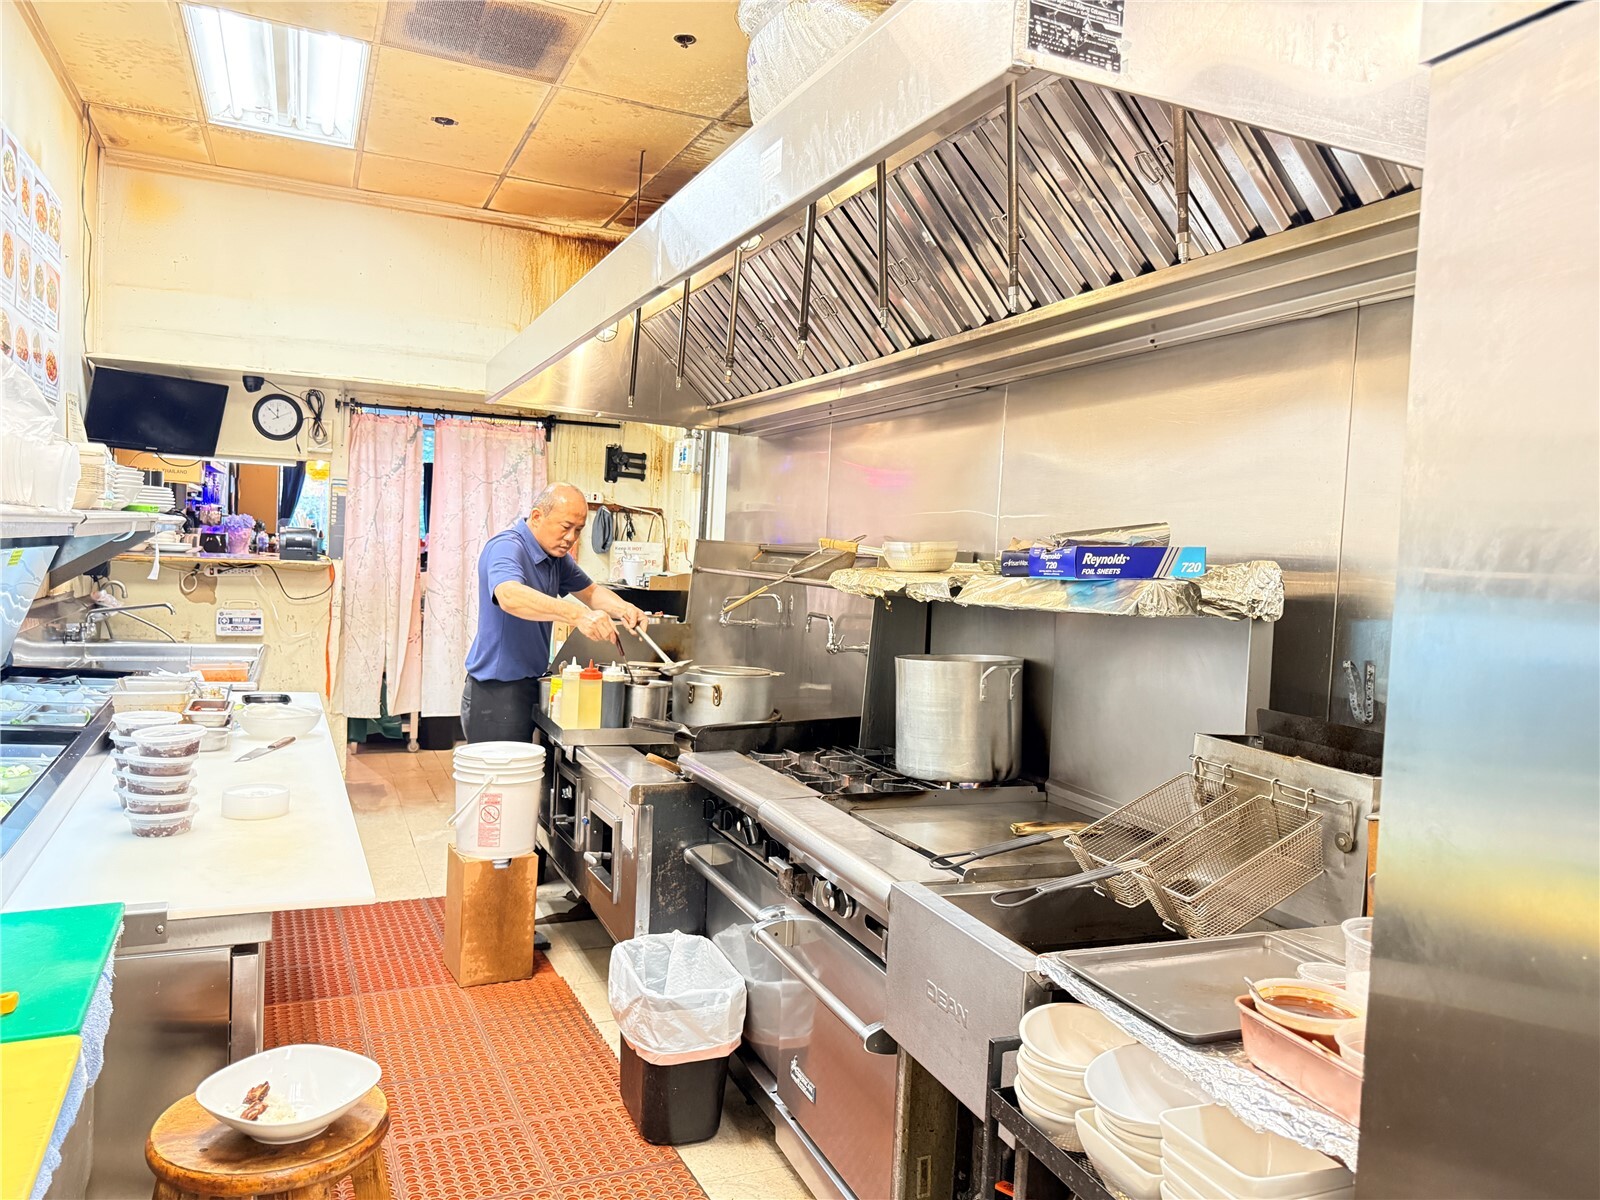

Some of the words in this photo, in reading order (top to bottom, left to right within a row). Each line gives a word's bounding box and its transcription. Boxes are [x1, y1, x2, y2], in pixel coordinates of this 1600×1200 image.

[1045, 561, 1058, 569] 720
[1082, 552, 1128, 567] Reynolds
[1181, 562, 1202, 573] 720
[926, 979, 969, 1030] DEAN
